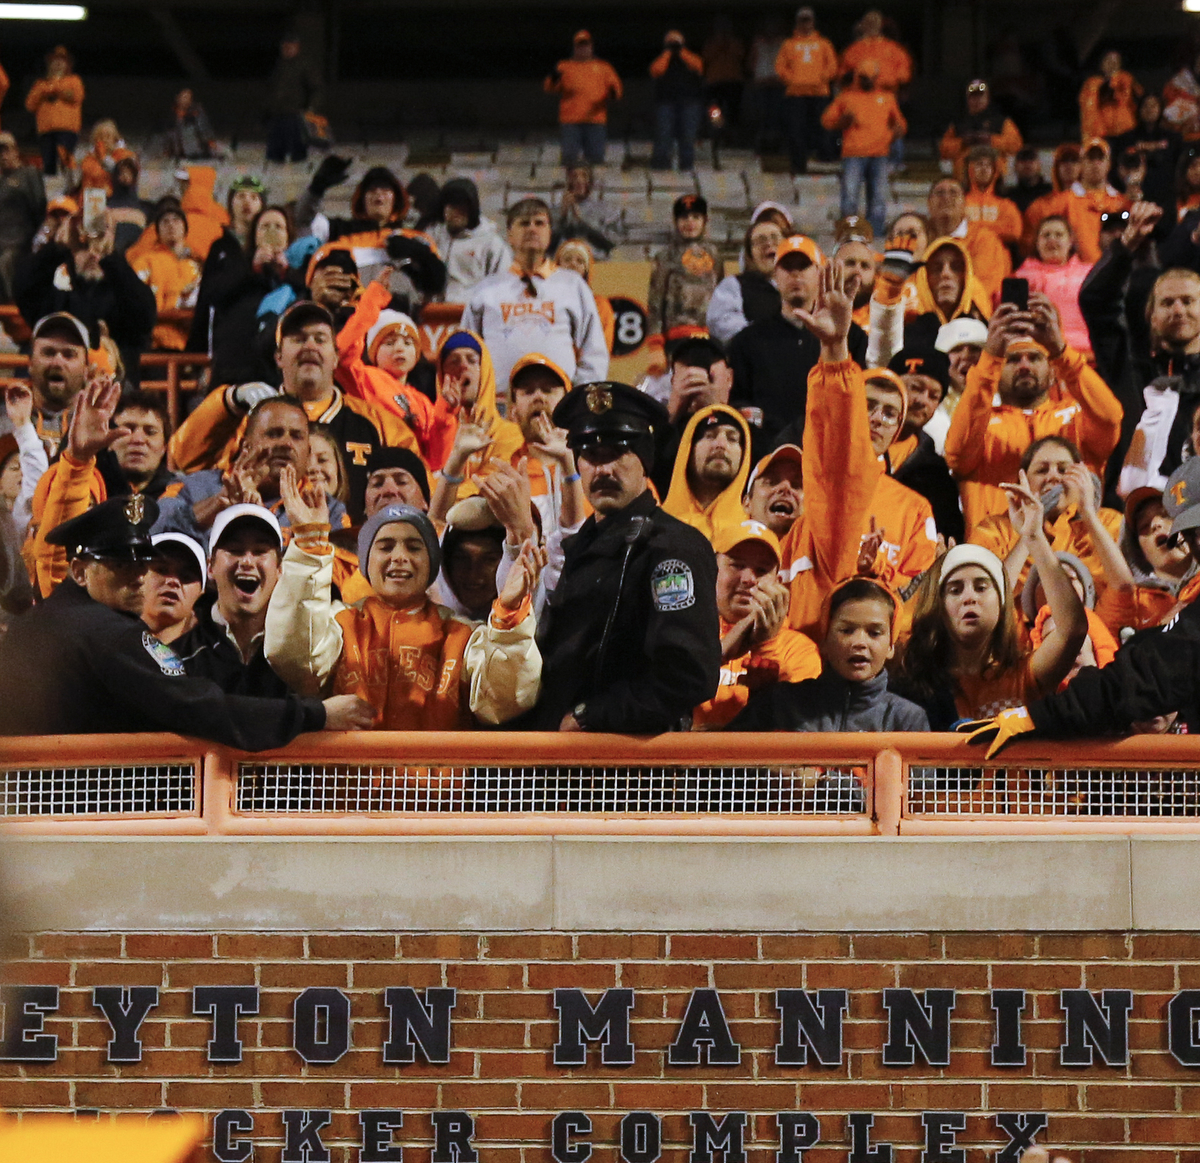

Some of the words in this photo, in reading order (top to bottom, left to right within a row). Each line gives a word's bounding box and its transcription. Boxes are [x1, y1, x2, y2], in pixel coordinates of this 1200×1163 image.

[613, 310, 643, 345] 8
[905, 358, 924, 374] T
[346, 441, 372, 466] T
[1170, 481, 1187, 505] T
